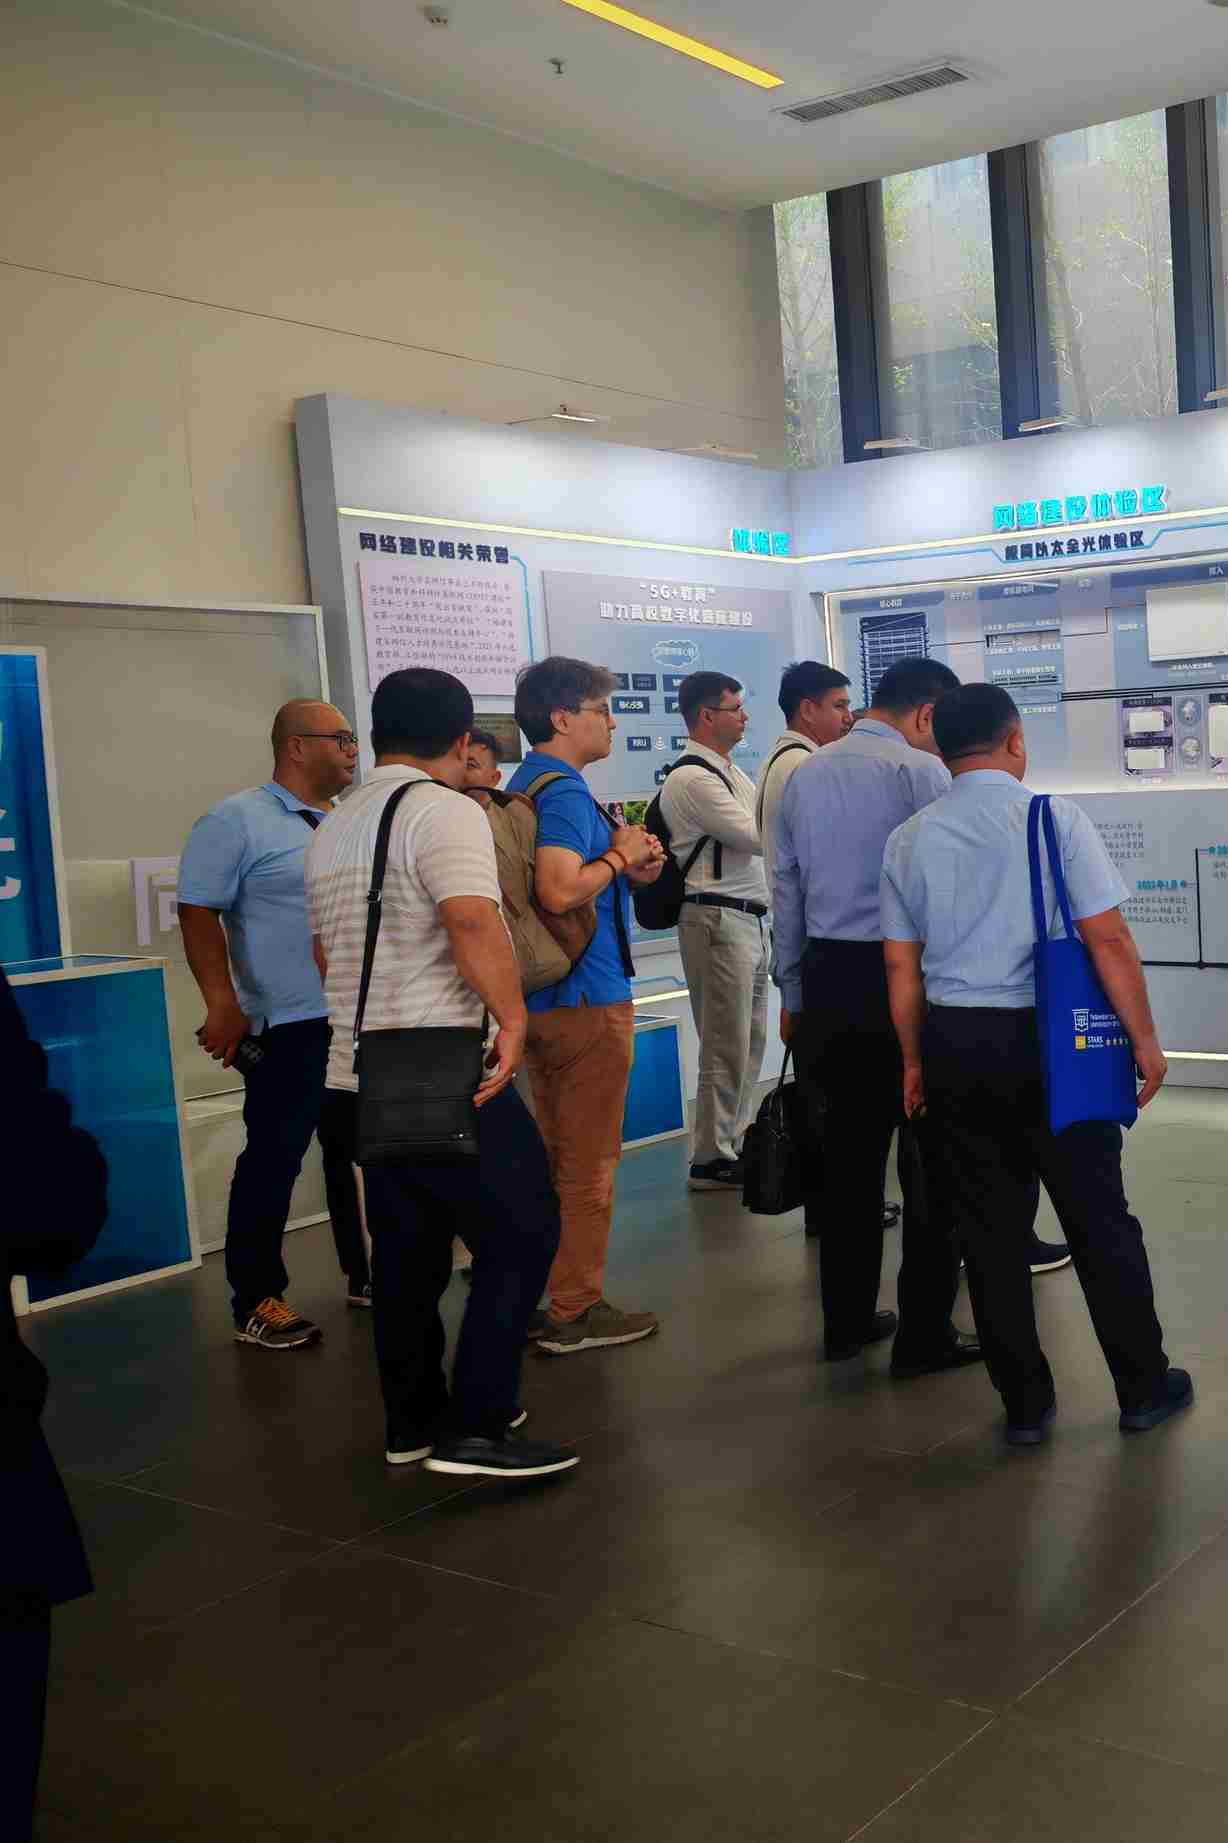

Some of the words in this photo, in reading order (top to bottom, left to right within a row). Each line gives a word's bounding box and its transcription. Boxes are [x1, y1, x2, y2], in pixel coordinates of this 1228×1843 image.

[992, 486, 1166, 529] 网络建设体验区
[359, 532, 509, 564] 网络建设相关荣誉
